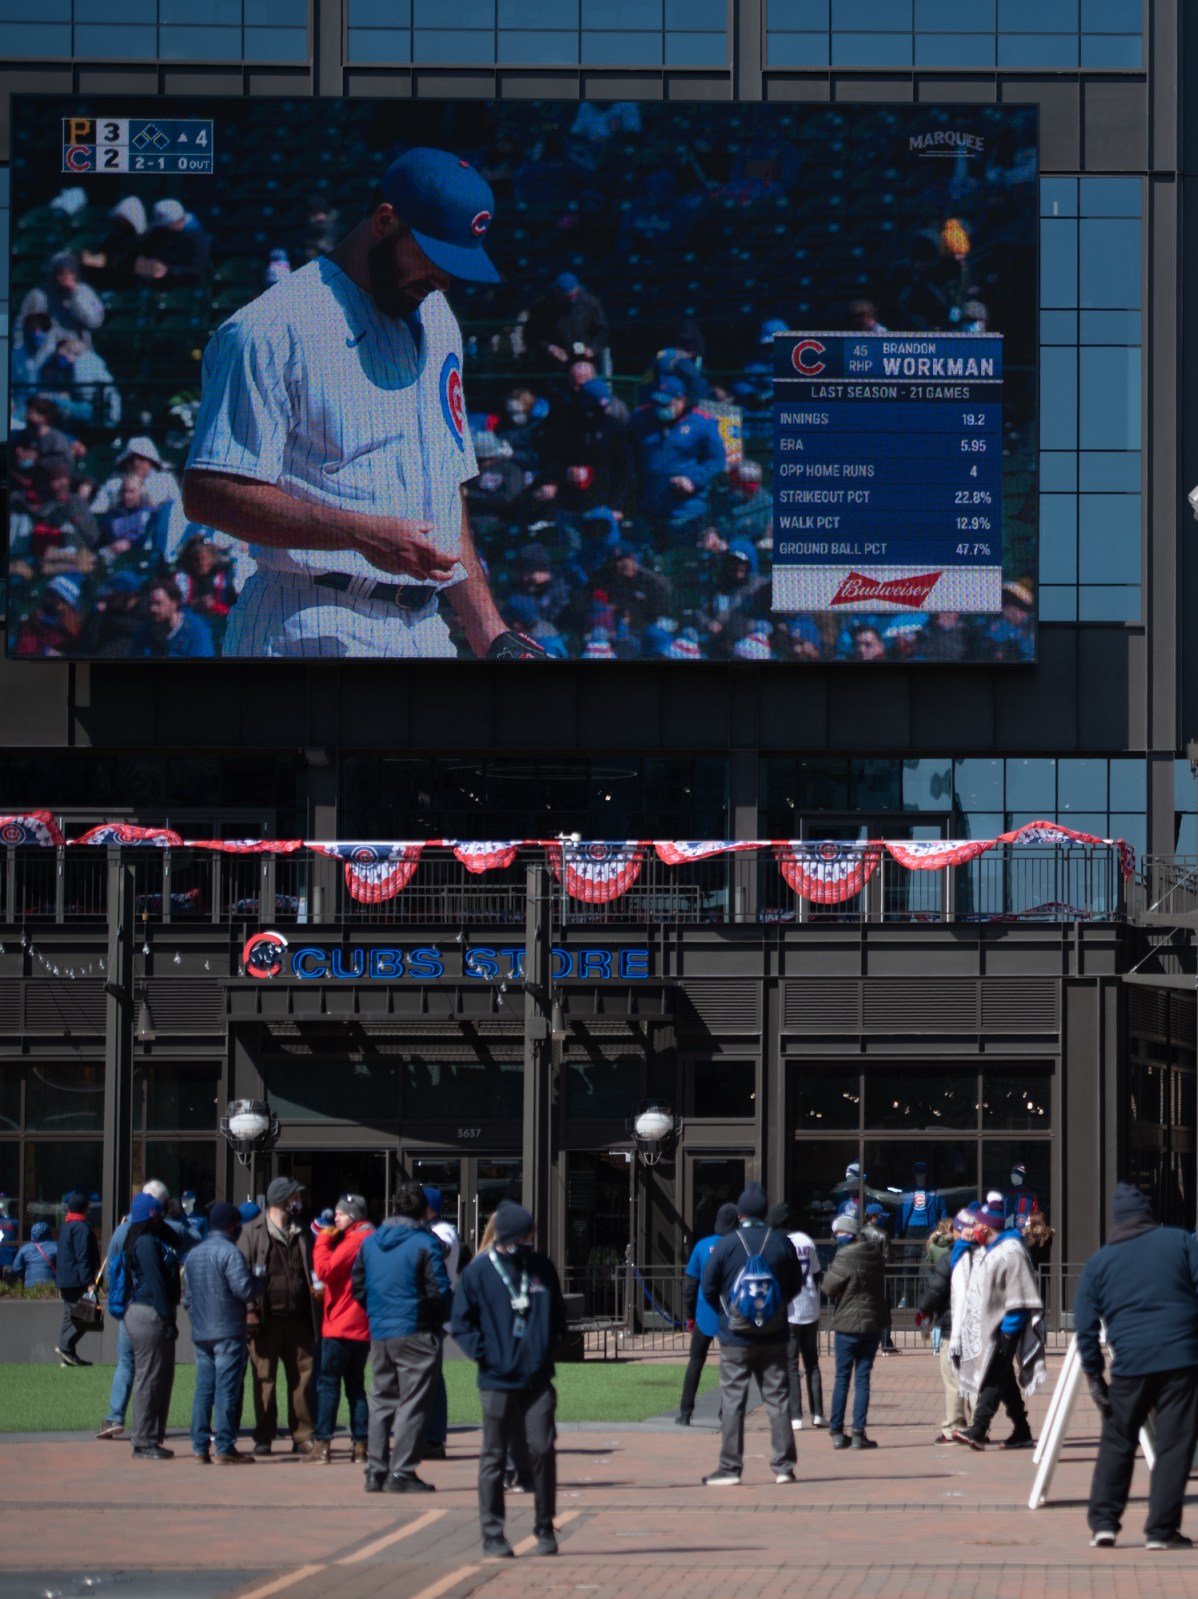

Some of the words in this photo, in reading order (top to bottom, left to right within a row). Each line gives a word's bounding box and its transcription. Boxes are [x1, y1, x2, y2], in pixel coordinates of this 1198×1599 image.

[103, 122, 120, 142] 3
[195, 129, 208, 147] 4
[909, 131, 984, 152] MARQUEE
[66, 146, 91, 171] C
[103, 149, 119, 168] 2
[178, 157, 187, 169] 0
[189, 160, 210, 169] OUT
[852, 345, 868, 357] 45
[882, 343, 936, 354] BRANDON
[849, 360, 873, 372] RHP
[883, 357, 994, 376] WORKMAN
[811, 386, 843, 398] LAST
[847, 386, 897, 398] SEASON
[909, 387, 923, 398] 21
[926, 387, 970, 399] GAMES
[780, 412, 829, 425] INNINGS
[962, 413, 985, 426] 19.2
[780, 438, 804, 451] ERA
[960, 439, 986, 452] 5.95
[780, 464, 804, 476] OPP
[806, 464, 840, 477] HOME
[843, 464, 875, 477] RUNS
[969, 465, 977, 477] 4
[779, 490, 844, 503] STRIKEOUT
[847, 490, 870, 503] PCT
[954, 491, 991, 504] 22.8%
[779, 516, 814, 529] WALK
[817, 516, 840, 529] PCT
[955, 517, 991, 530] 12.9%
[779, 542, 829, 555] GROUND
[831, 543, 861, 555] BALL
[864, 543, 888, 555] PCT
[955, 543, 991, 556] 47.7%
[839, 577, 934, 598] Budweiser
[291, 947, 444, 979] CUBS
[457, 1128, 481, 1138] 3637
